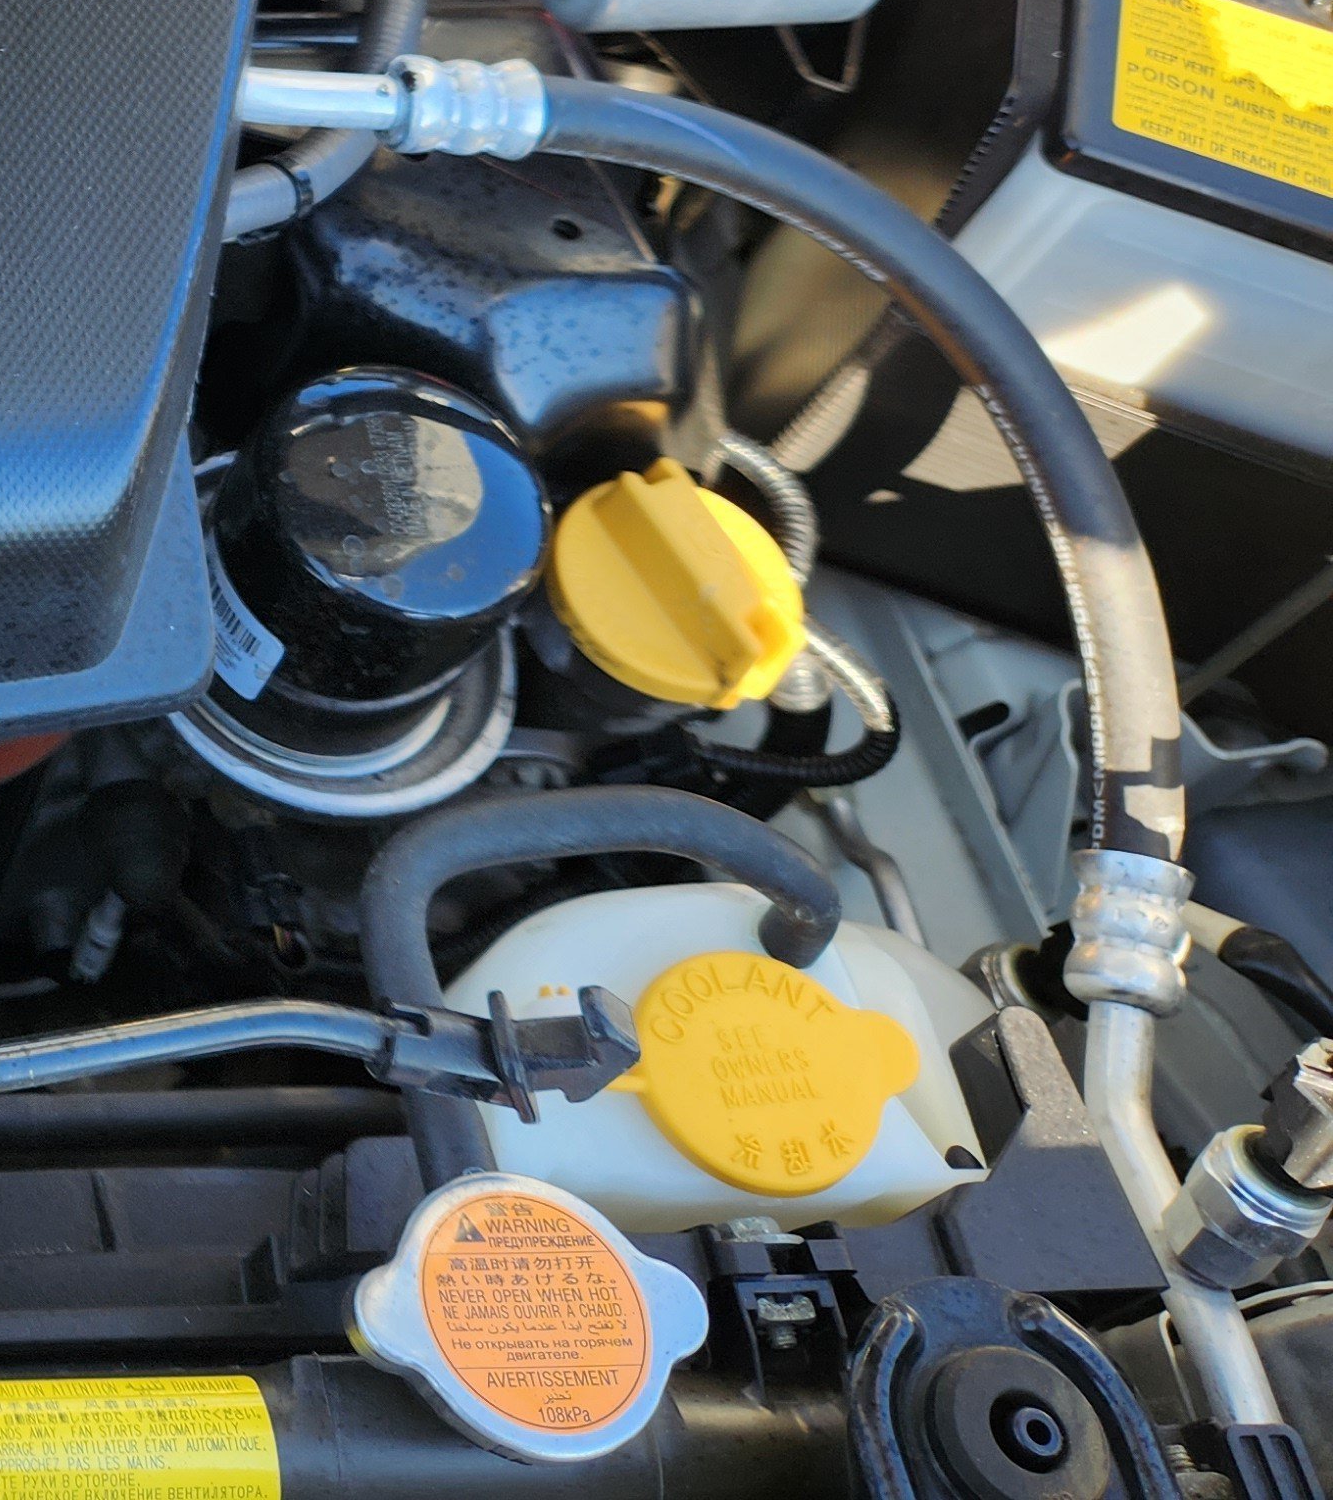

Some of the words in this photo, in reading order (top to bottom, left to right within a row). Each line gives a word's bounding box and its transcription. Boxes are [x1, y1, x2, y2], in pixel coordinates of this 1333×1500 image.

[1127, 62, 1215, 101] POISON
[650, 962, 837, 1045] COOLANT
[716, 1025, 770, 1051] SEE
[712, 1049, 810, 1082] OWNERS
[719, 1077, 817, 1109] MANUAL
[484, 1202, 533, 1216] 警告
[484, 1218, 570, 1233] WARNING
[488, 1235, 595, 1249] ПРЕДУПРЕЖДЕНИЕ
[449, 1256, 595, 1271] 高温时请勿打开
[438, 1289, 486, 1303] NEVER
[492, 1288, 531, 1302] OPEN
[536, 1288, 583, 1301] WHEN
[589, 1286, 622, 1300] HOT.
[443, 1306, 459, 1319] NE
[464, 1305, 509, 1318] JAMAIS
[514, 1304, 561, 1318] OUVRIR
[579, 1303, 627, 1317] CHAUD.
[452, 1337, 472, 1350] Не
[475, 1338, 549, 1352] открывать
[553, 1336, 570, 1348] на
[573, 1336, 633, 1349] горячем
[52, 1380, 118, 1395] ATTENTION
[487, 1370, 619, 1388] AVERTISSEMENT
[538, 1406, 591, 1423] 108kPa
[71, 1424, 93, 1438] FAN
[99, 1423, 142, 1437] STARTS
[149, 1421, 245, 1436] AUTOMATICALLY.
[42, 1440, 56, 1455] DU
[62, 1438, 138, 1455] VENTILATEUR
[186, 1436, 268, 1451] AUTOMATIQUE.
[67, 1457, 91, 1471] PAS
[98, 1456, 121, 1471] LES
[127, 1455, 172, 1470] MAINS.
[23, 1475, 57, 1489] РУКИ
[75, 1472, 141, 1488] СТОРОНЕ.
